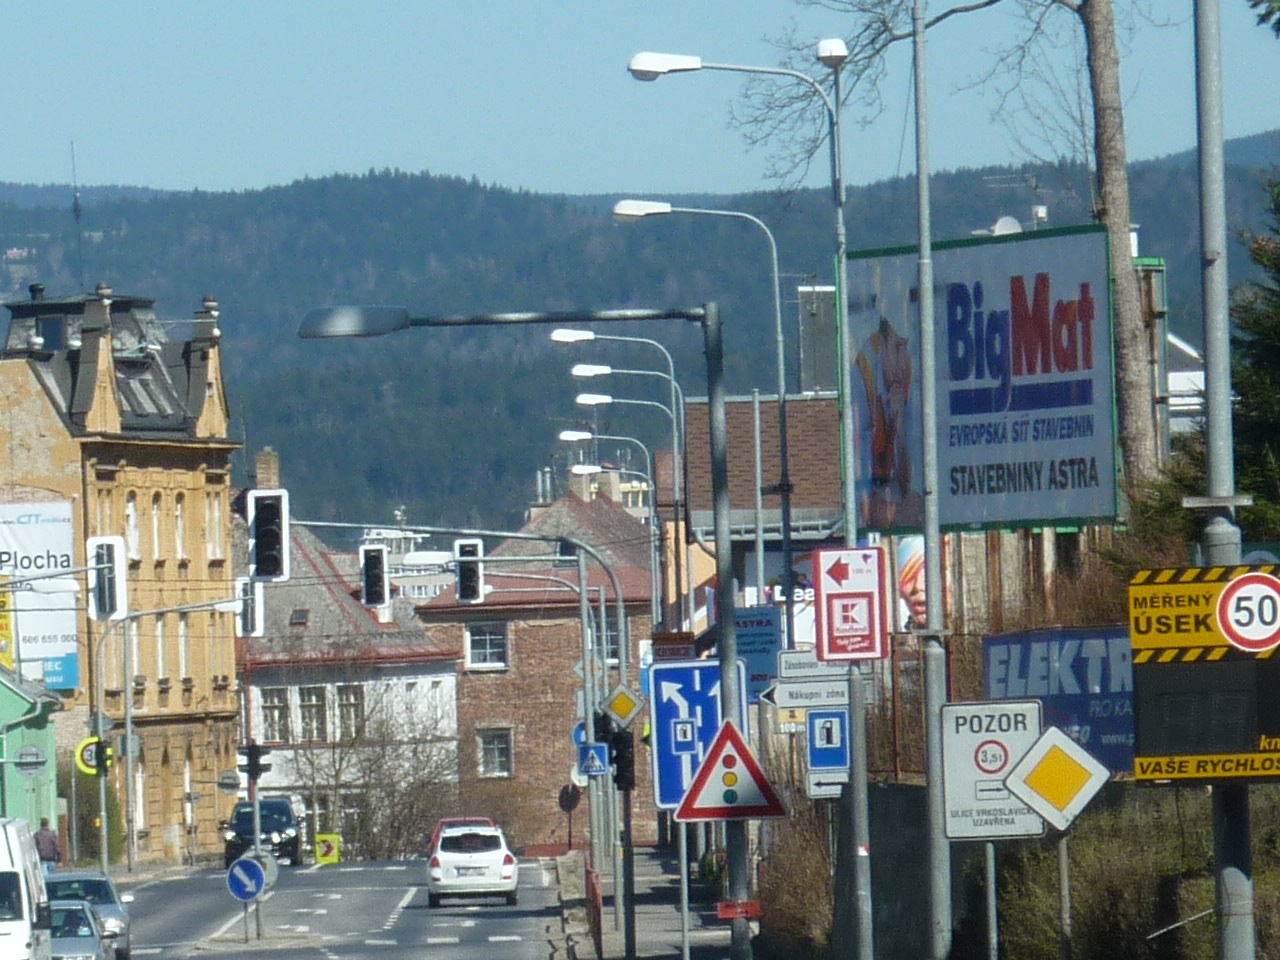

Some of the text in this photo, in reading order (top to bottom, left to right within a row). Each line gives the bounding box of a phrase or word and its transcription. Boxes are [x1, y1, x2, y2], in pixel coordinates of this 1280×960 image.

[946, 272, 1095, 413] BigMat
[949, 416, 1007, 447] EVROPSKÁ
[1032, 413, 1095, 443] STAVEBNIN
[950, 456, 1099, 496] STAVEBNINY ASTRA
[1134, 591, 1214, 610] MĚŘENÝ
[1233, 595, 1278, 628] 50
[1134, 611, 1214, 636] ÚSEK
[989, 637, 1133, 700] ELEKTR
[954, 713, 1028, 734] POZOR
[1140, 759, 1189, 774] VAŠE
